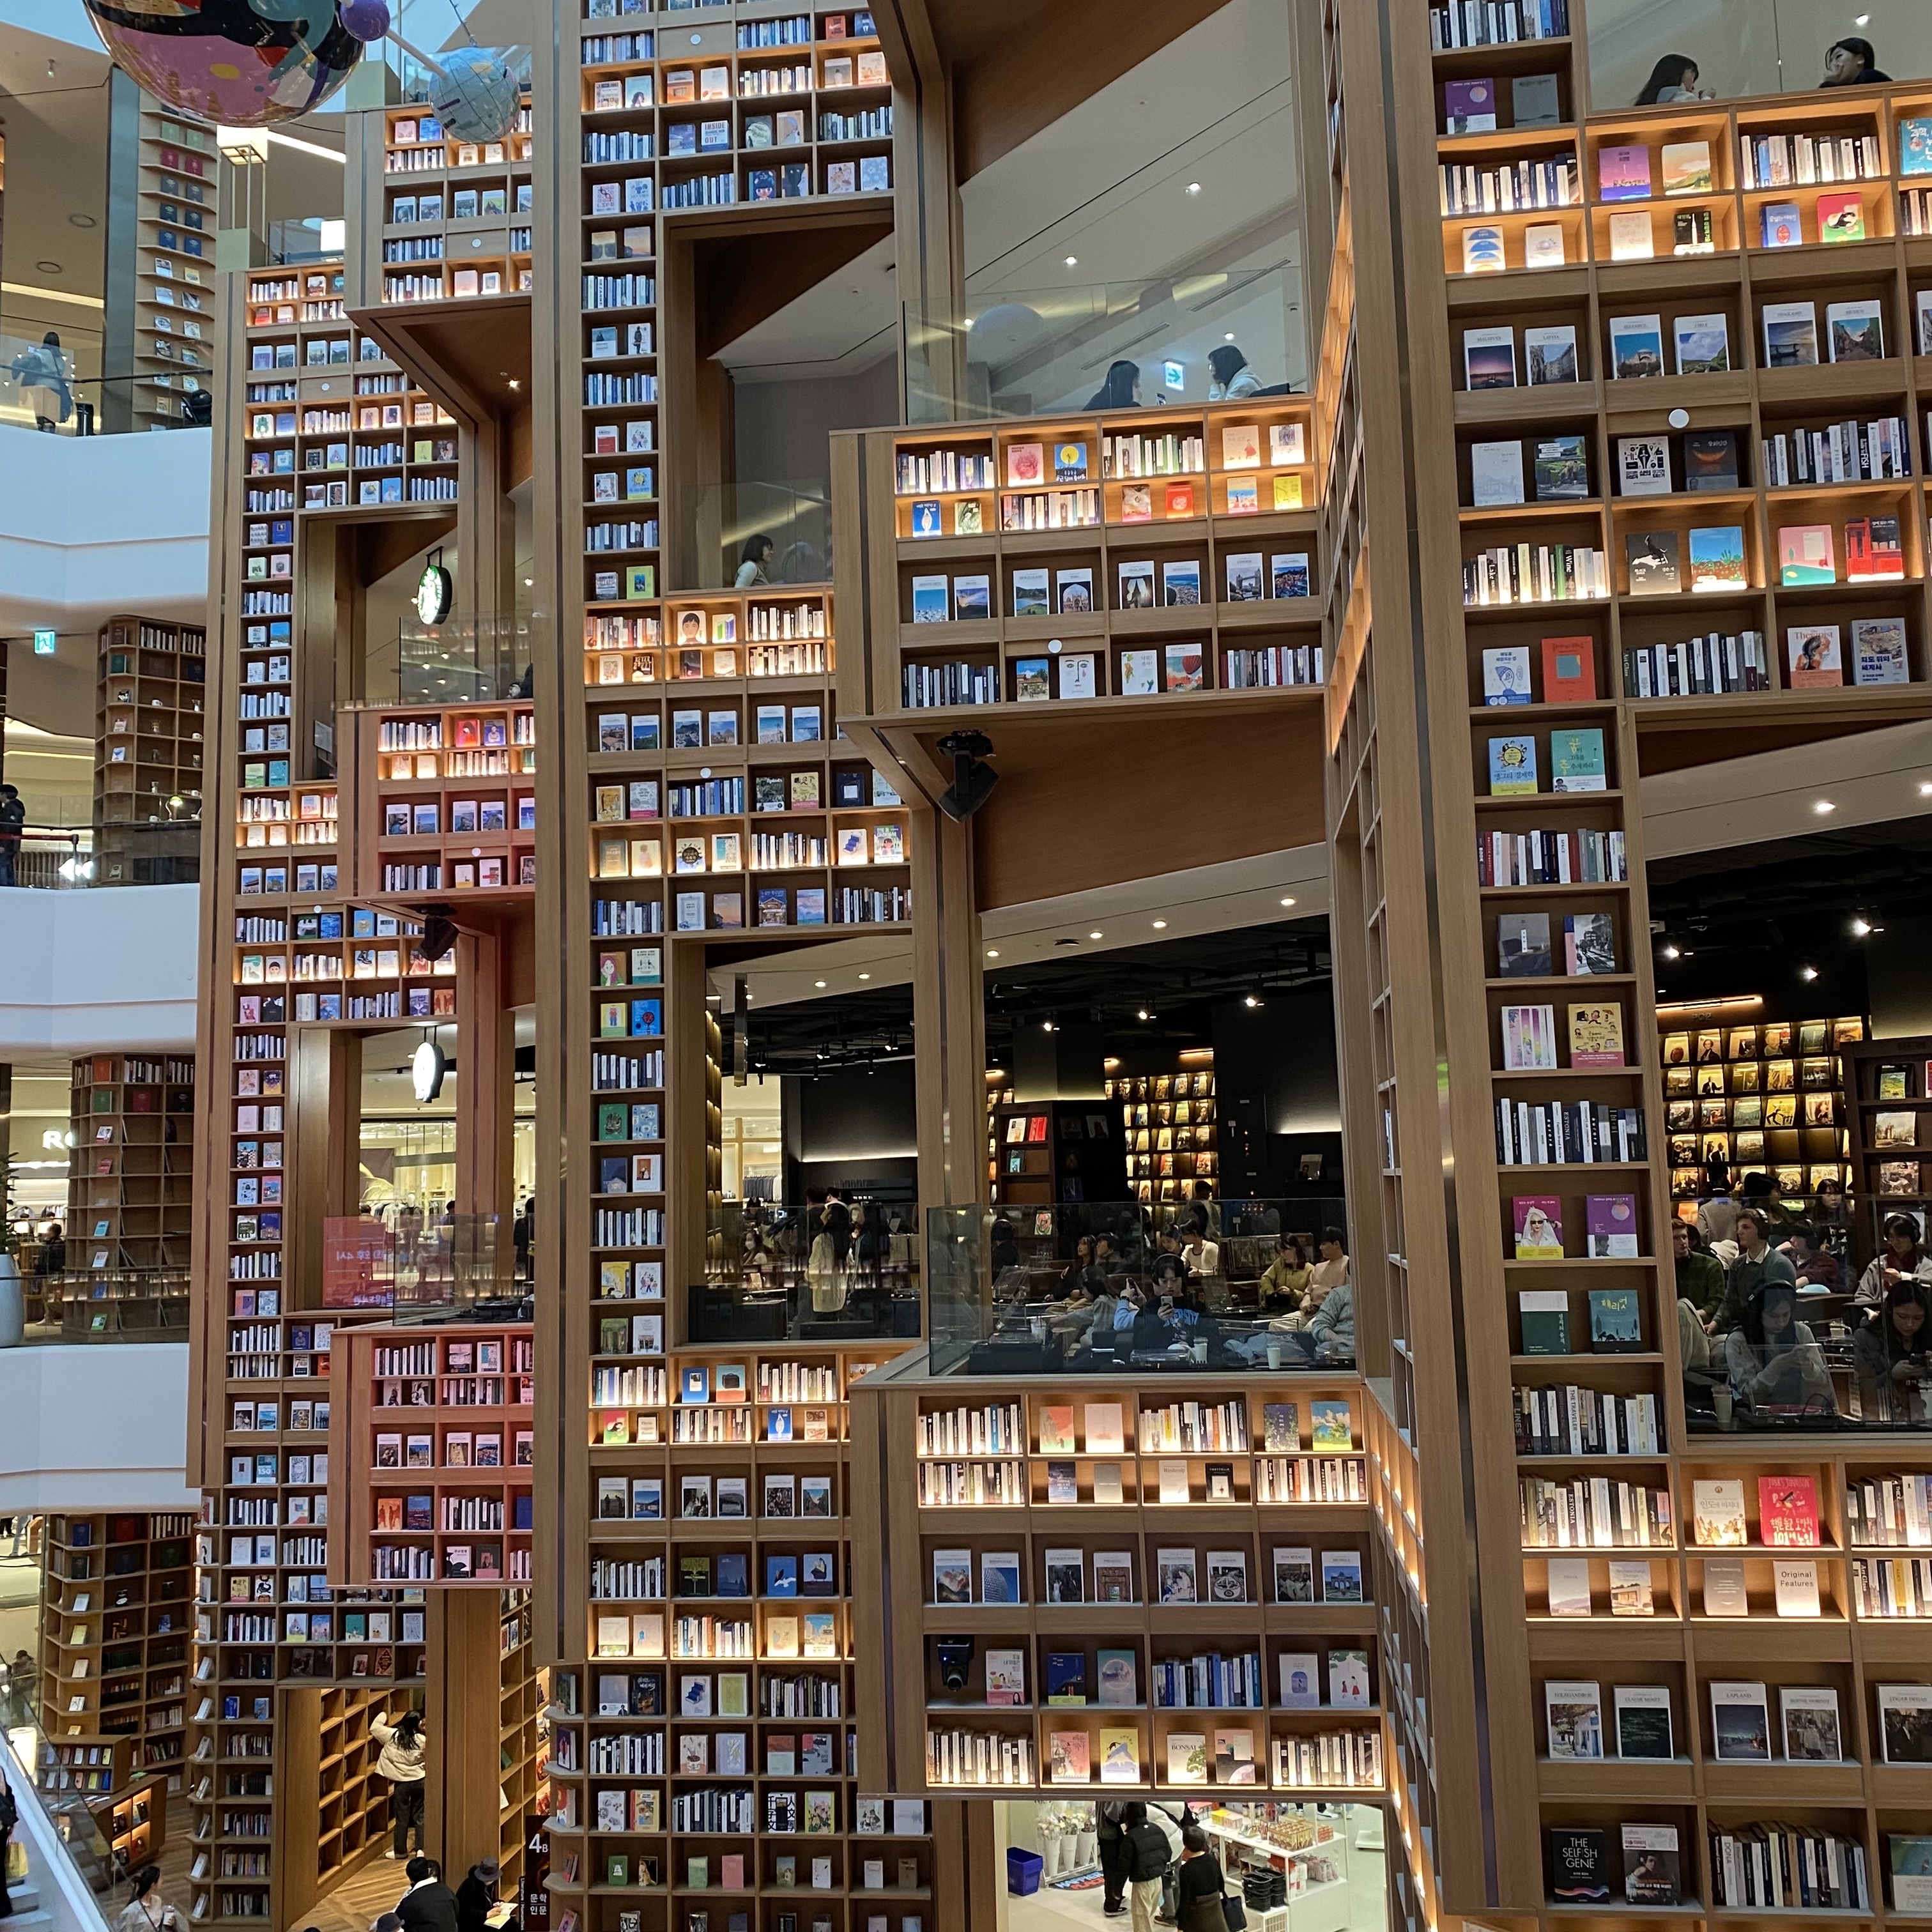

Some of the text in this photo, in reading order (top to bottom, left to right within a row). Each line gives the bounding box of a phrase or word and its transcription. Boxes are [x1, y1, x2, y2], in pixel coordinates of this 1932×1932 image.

[705, 122, 725, 130] INSIDE
[1860, 453, 1869, 468] FISH
[1489, 564, 1497, 580] Lake
[1795, 632, 1834, 640] Therapist
[1797, 1531, 1813, 1545] 노인
[1570, 1837, 1588, 1848] THE
[1565, 1859, 1595, 1869] GENE
[530, 1894, 548, 1903] 문학
[530, 1906, 548, 1915] 인문
